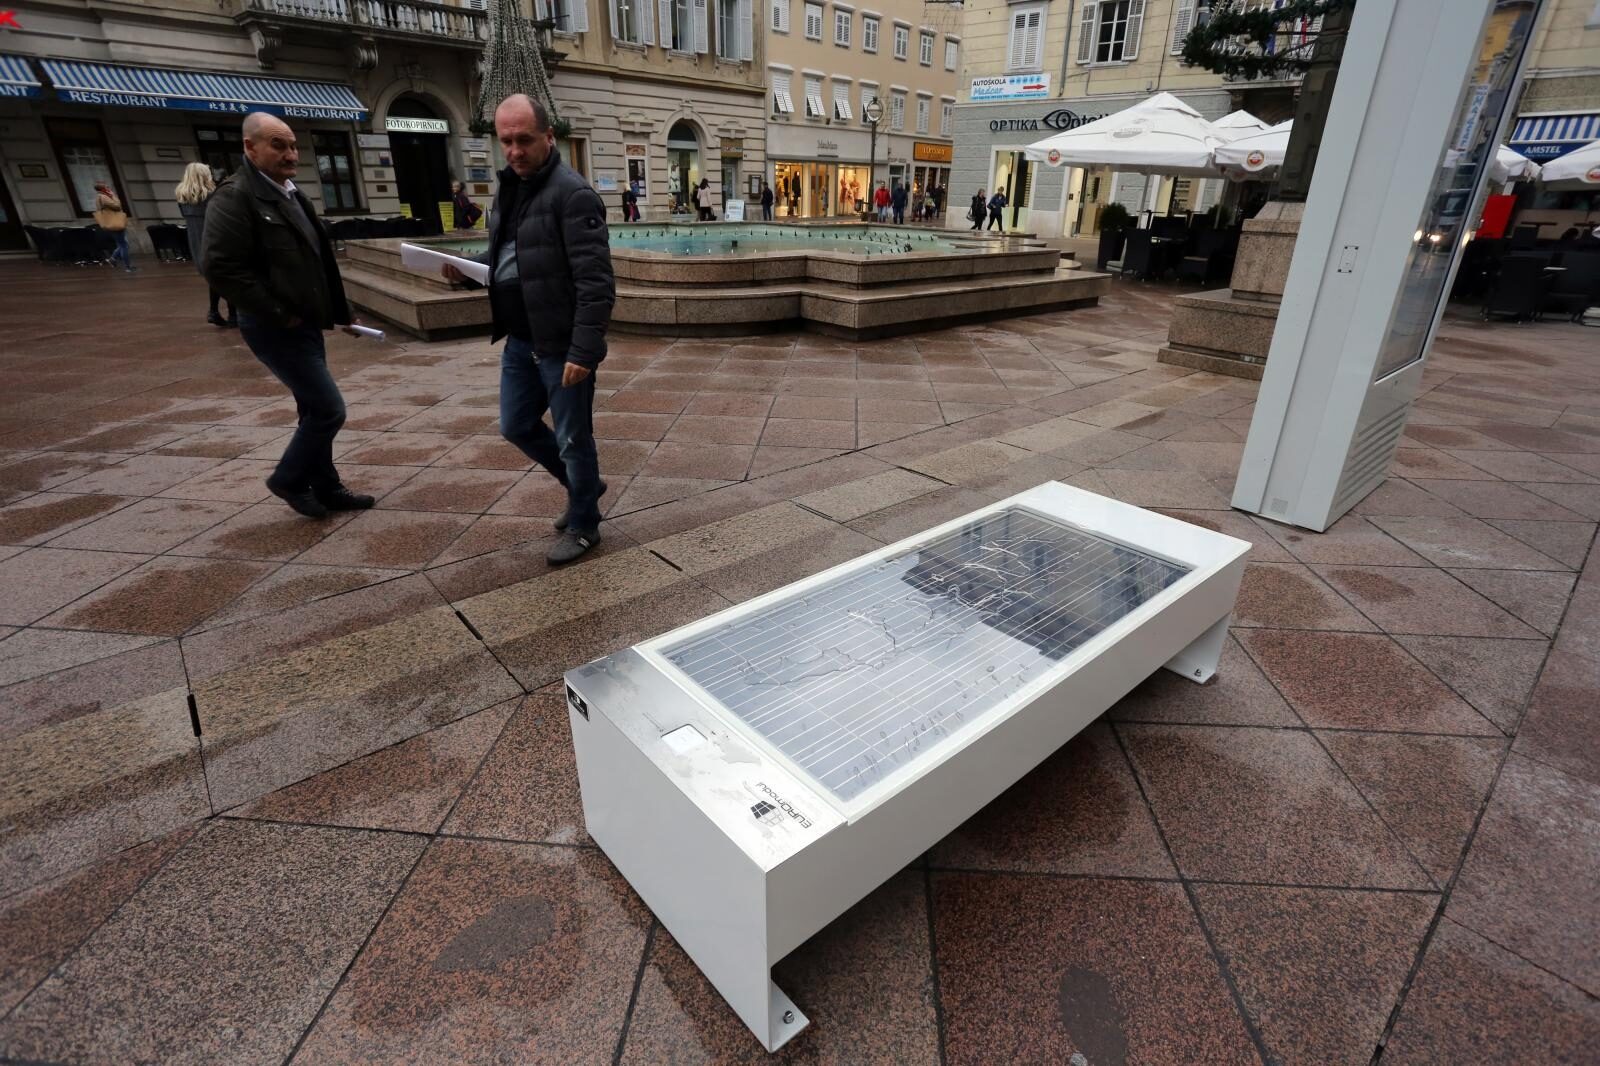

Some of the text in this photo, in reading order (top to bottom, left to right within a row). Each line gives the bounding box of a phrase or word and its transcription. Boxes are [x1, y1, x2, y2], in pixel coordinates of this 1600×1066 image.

[69, 90, 168, 108] RESTAURANT
[283, 106, 361, 120] RESTAURANT
[386, 119, 445, 131] FOTOKOPIRNICA
[989, 119, 1039, 132] OPTIKA
[1524, 145, 1561, 154] AMSTEL
